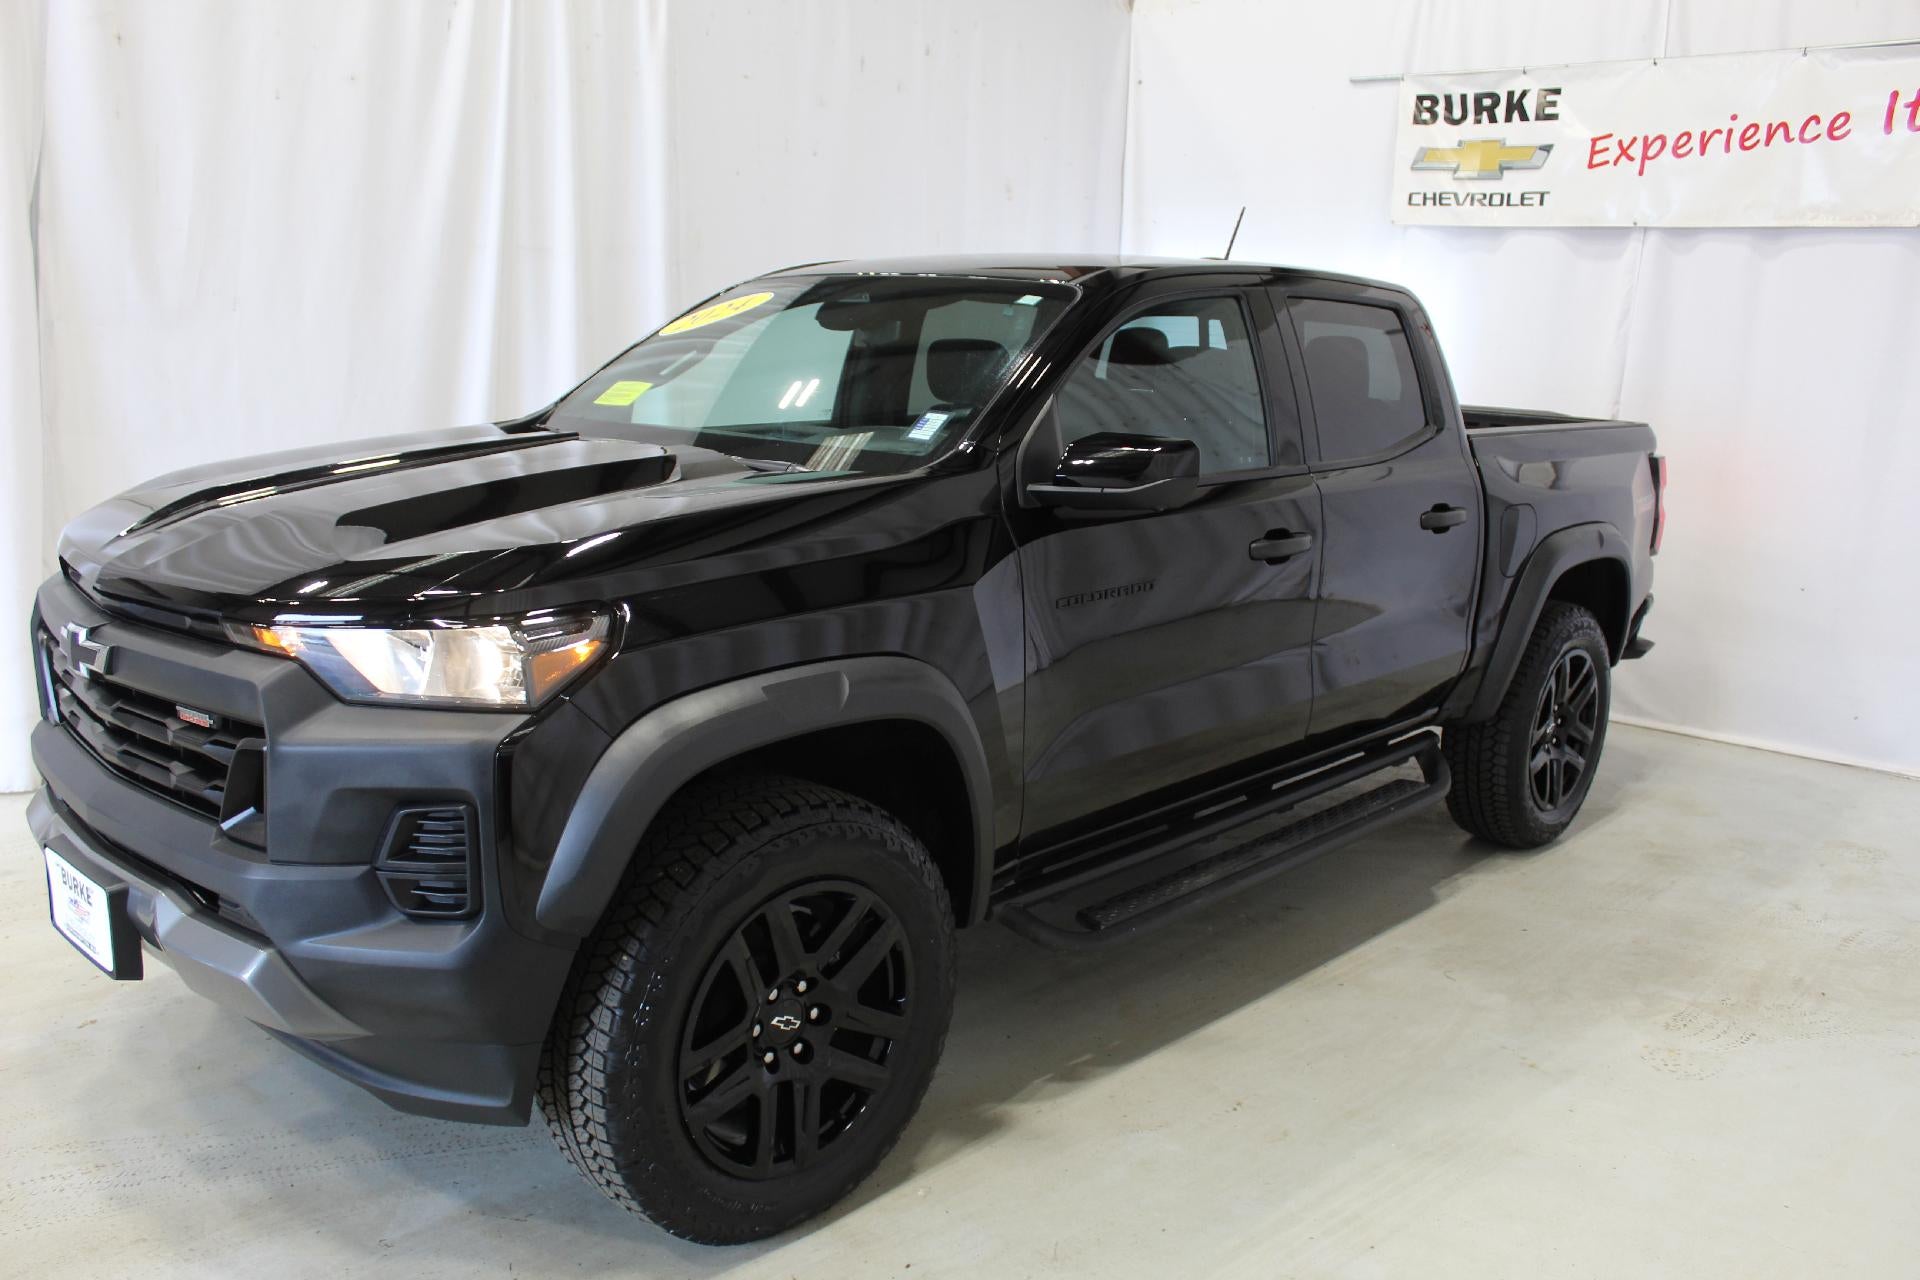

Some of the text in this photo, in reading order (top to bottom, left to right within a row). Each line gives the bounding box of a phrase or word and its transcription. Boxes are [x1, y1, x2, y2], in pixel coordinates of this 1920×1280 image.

[1412, 87, 1562, 126] BURKE
[1587, 111, 1852, 176] Experience
[1407, 190, 1551, 208] CHEVROLET
[1055, 580, 1156, 609] COLORADO
[61, 867, 92, 906] BURKE
